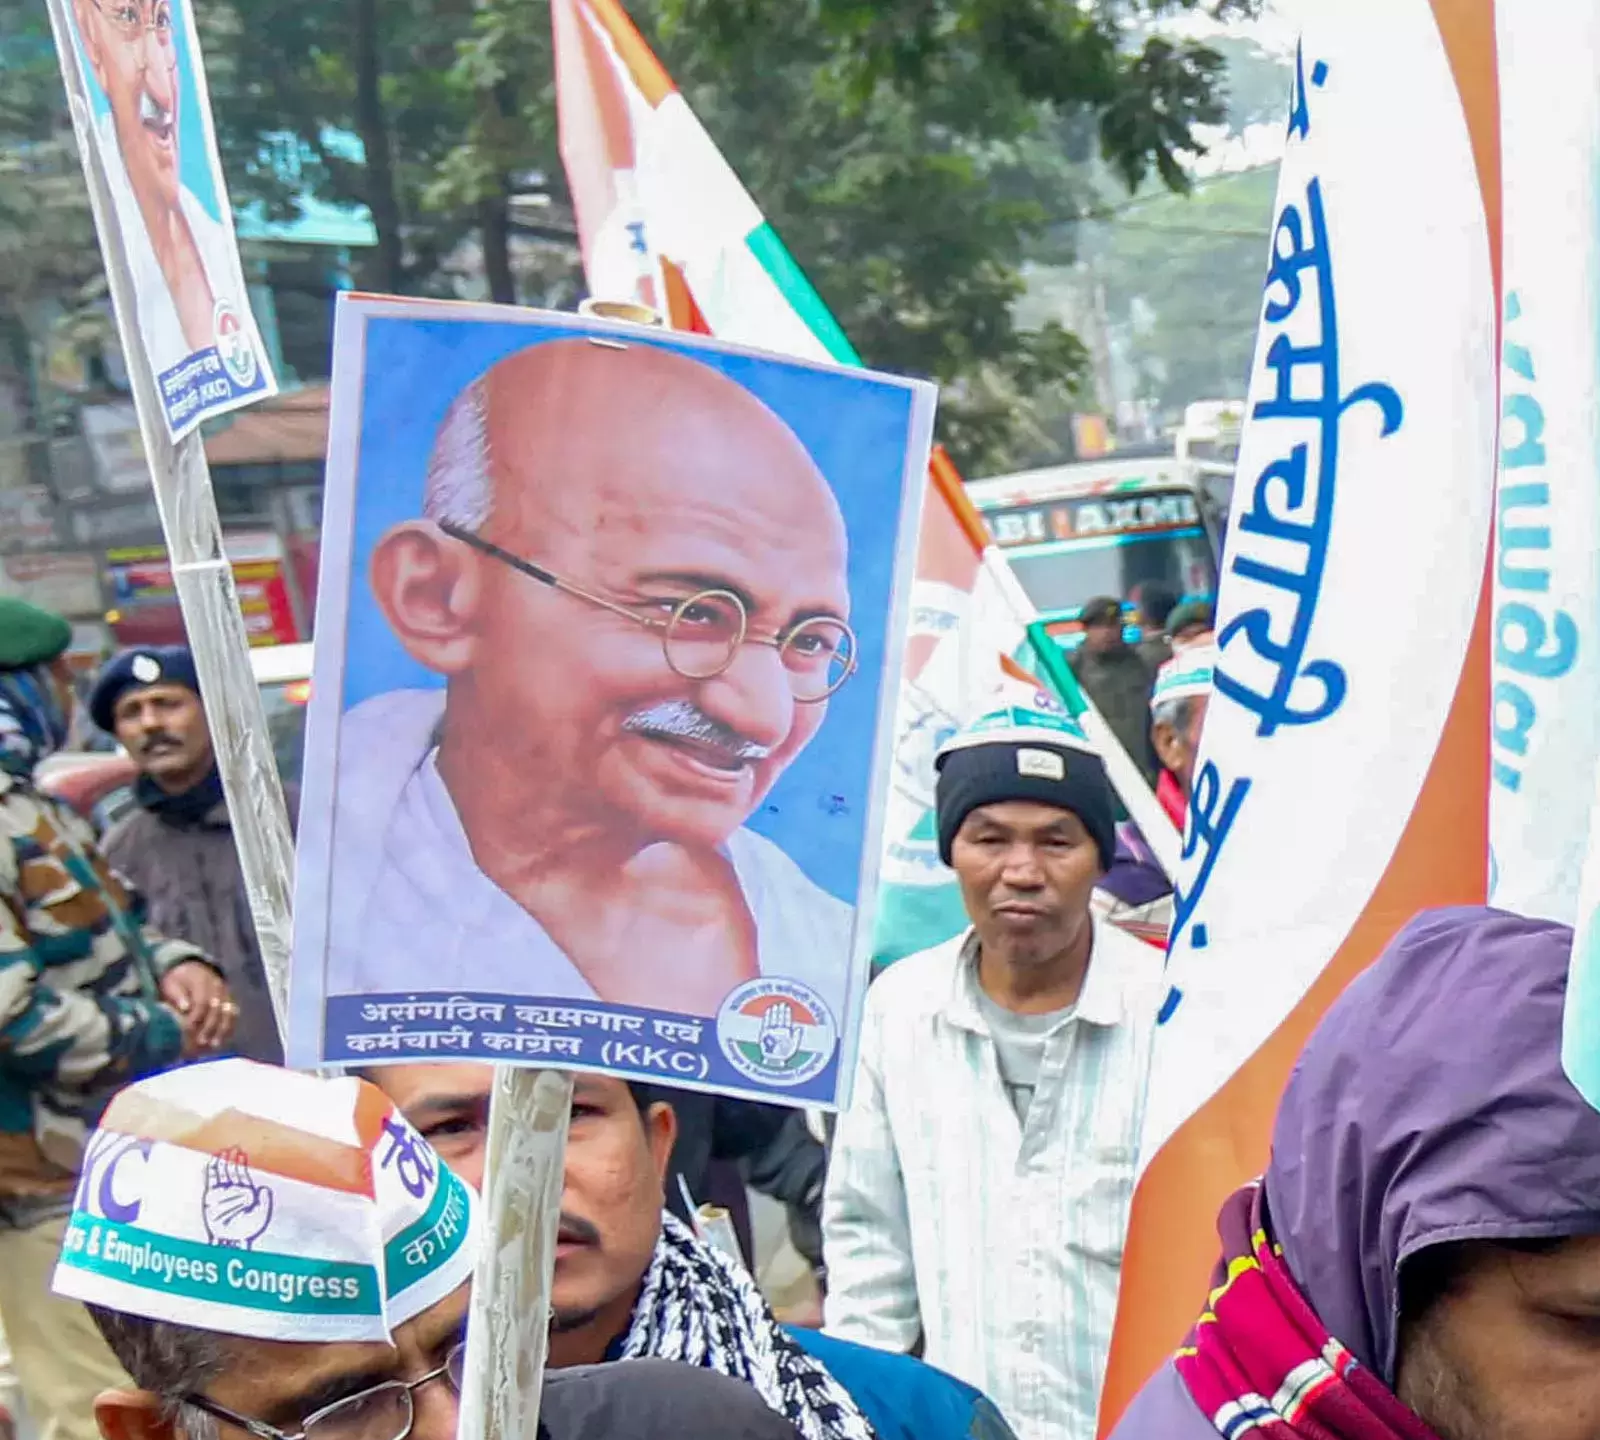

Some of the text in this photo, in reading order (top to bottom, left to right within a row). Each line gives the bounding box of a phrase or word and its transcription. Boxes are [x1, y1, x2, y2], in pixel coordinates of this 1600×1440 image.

[1211, 175, 1404, 738] कर्मचारी
[345, 1026, 583, 1056] कर्मचारी कांग्रेस
[360, 995, 704, 1046] असंगठित कामगार एवं
[600, 1044, 711, 1080] (KKC)
[103, 1228, 219, 1284] Employees
[226, 1258, 360, 1302] Congress
